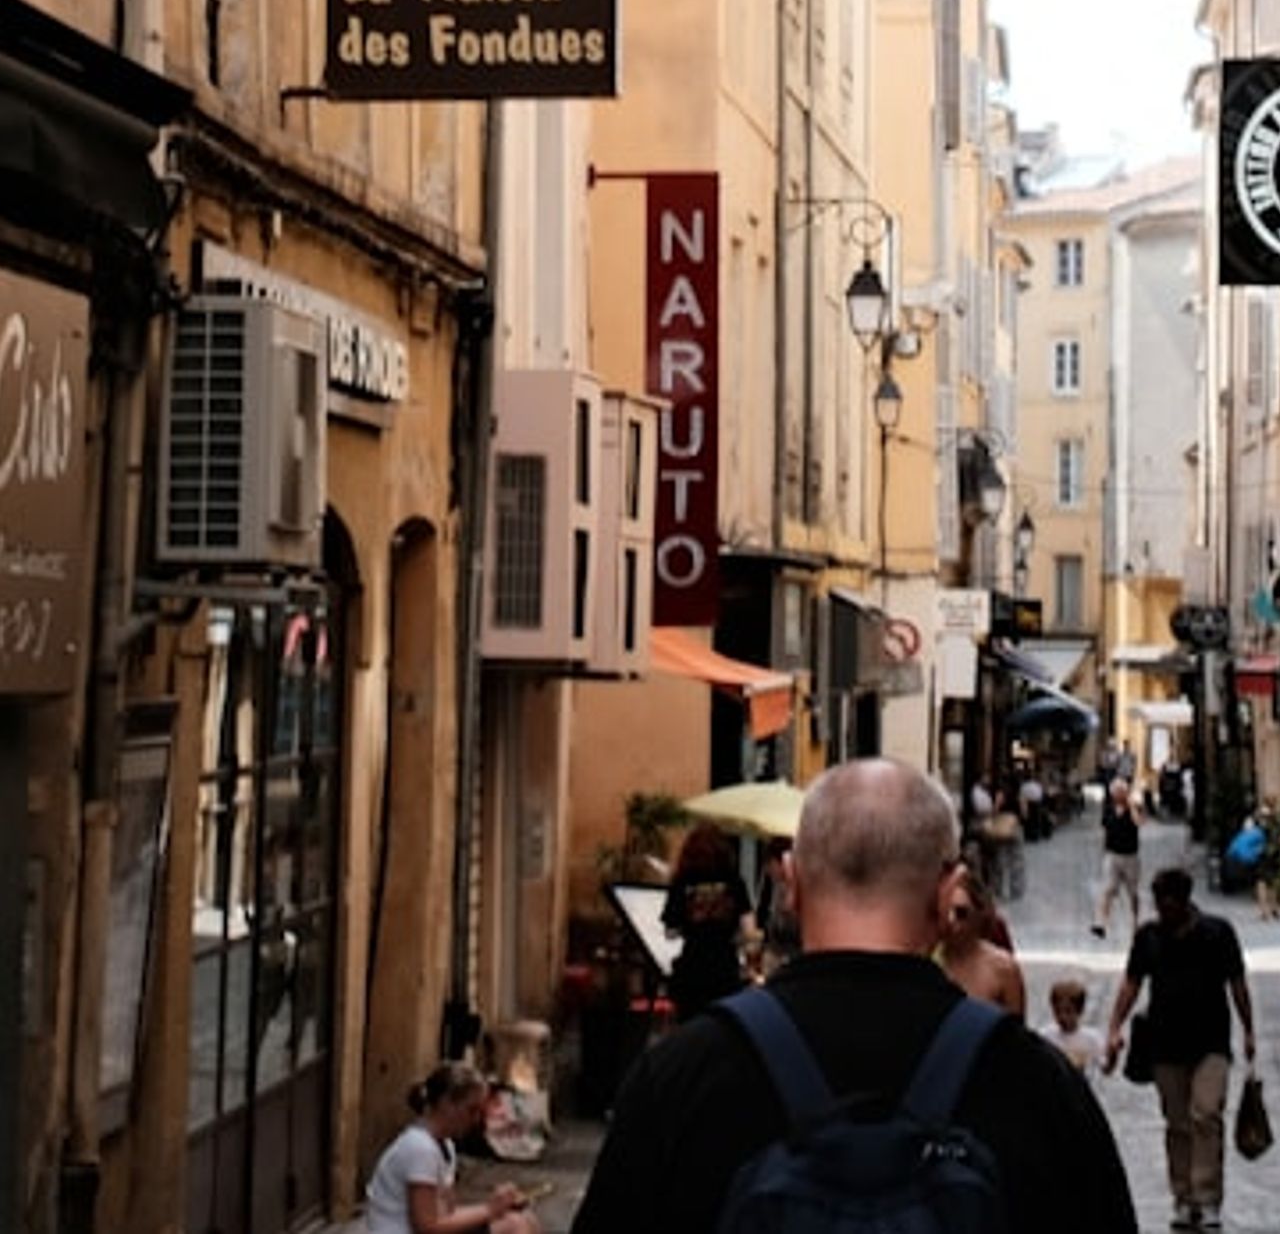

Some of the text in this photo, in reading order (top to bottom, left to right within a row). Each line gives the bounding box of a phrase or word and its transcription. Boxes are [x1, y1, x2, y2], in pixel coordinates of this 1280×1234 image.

[338, 14, 606, 65] des Fondues
[656, 208, 706, 589] NARUTO
